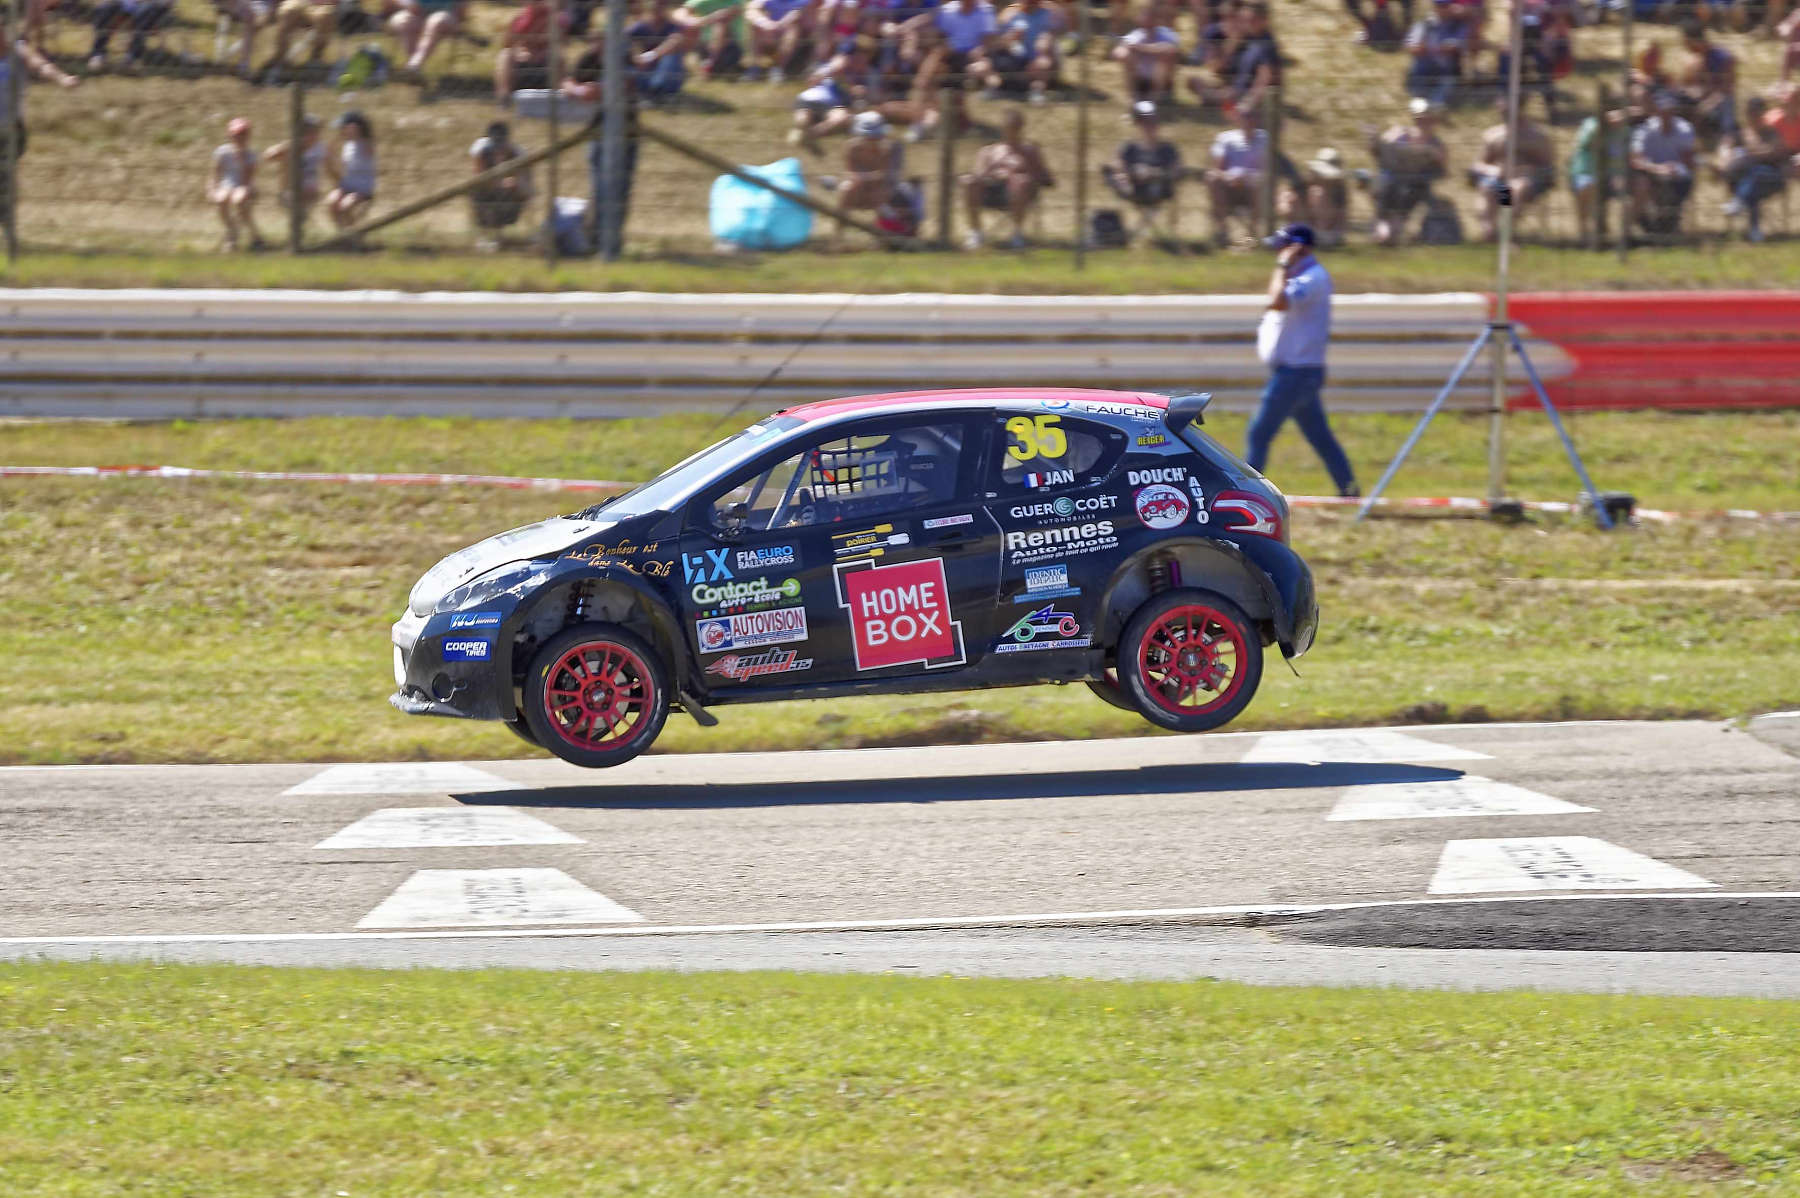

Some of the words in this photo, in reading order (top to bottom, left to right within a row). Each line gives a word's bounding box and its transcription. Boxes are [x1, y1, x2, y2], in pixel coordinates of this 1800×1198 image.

[1085, 404, 1160, 419] FAUCHE
[1005, 414, 1068, 460] 35
[1044, 469, 1075, 485] JAN
[1127, 467, 1187, 486] DOUCH'
[1189, 476, 1209, 524] AUTO
[1007, 520, 1114, 550] Rennes
[1011, 536, 1118, 559] Auto-Moto
[1022, 553, 1054, 563] magazine
[738, 554, 795, 570] RALLYCROSS
[691, 576, 768, 605] Contact
[861, 581, 938, 617] HOME
[733, 609, 804, 636] AUTOVISION
[866, 610, 943, 646] BOX
[445, 641, 488, 652] COOPER
[466, 649, 487, 657] TIRES
